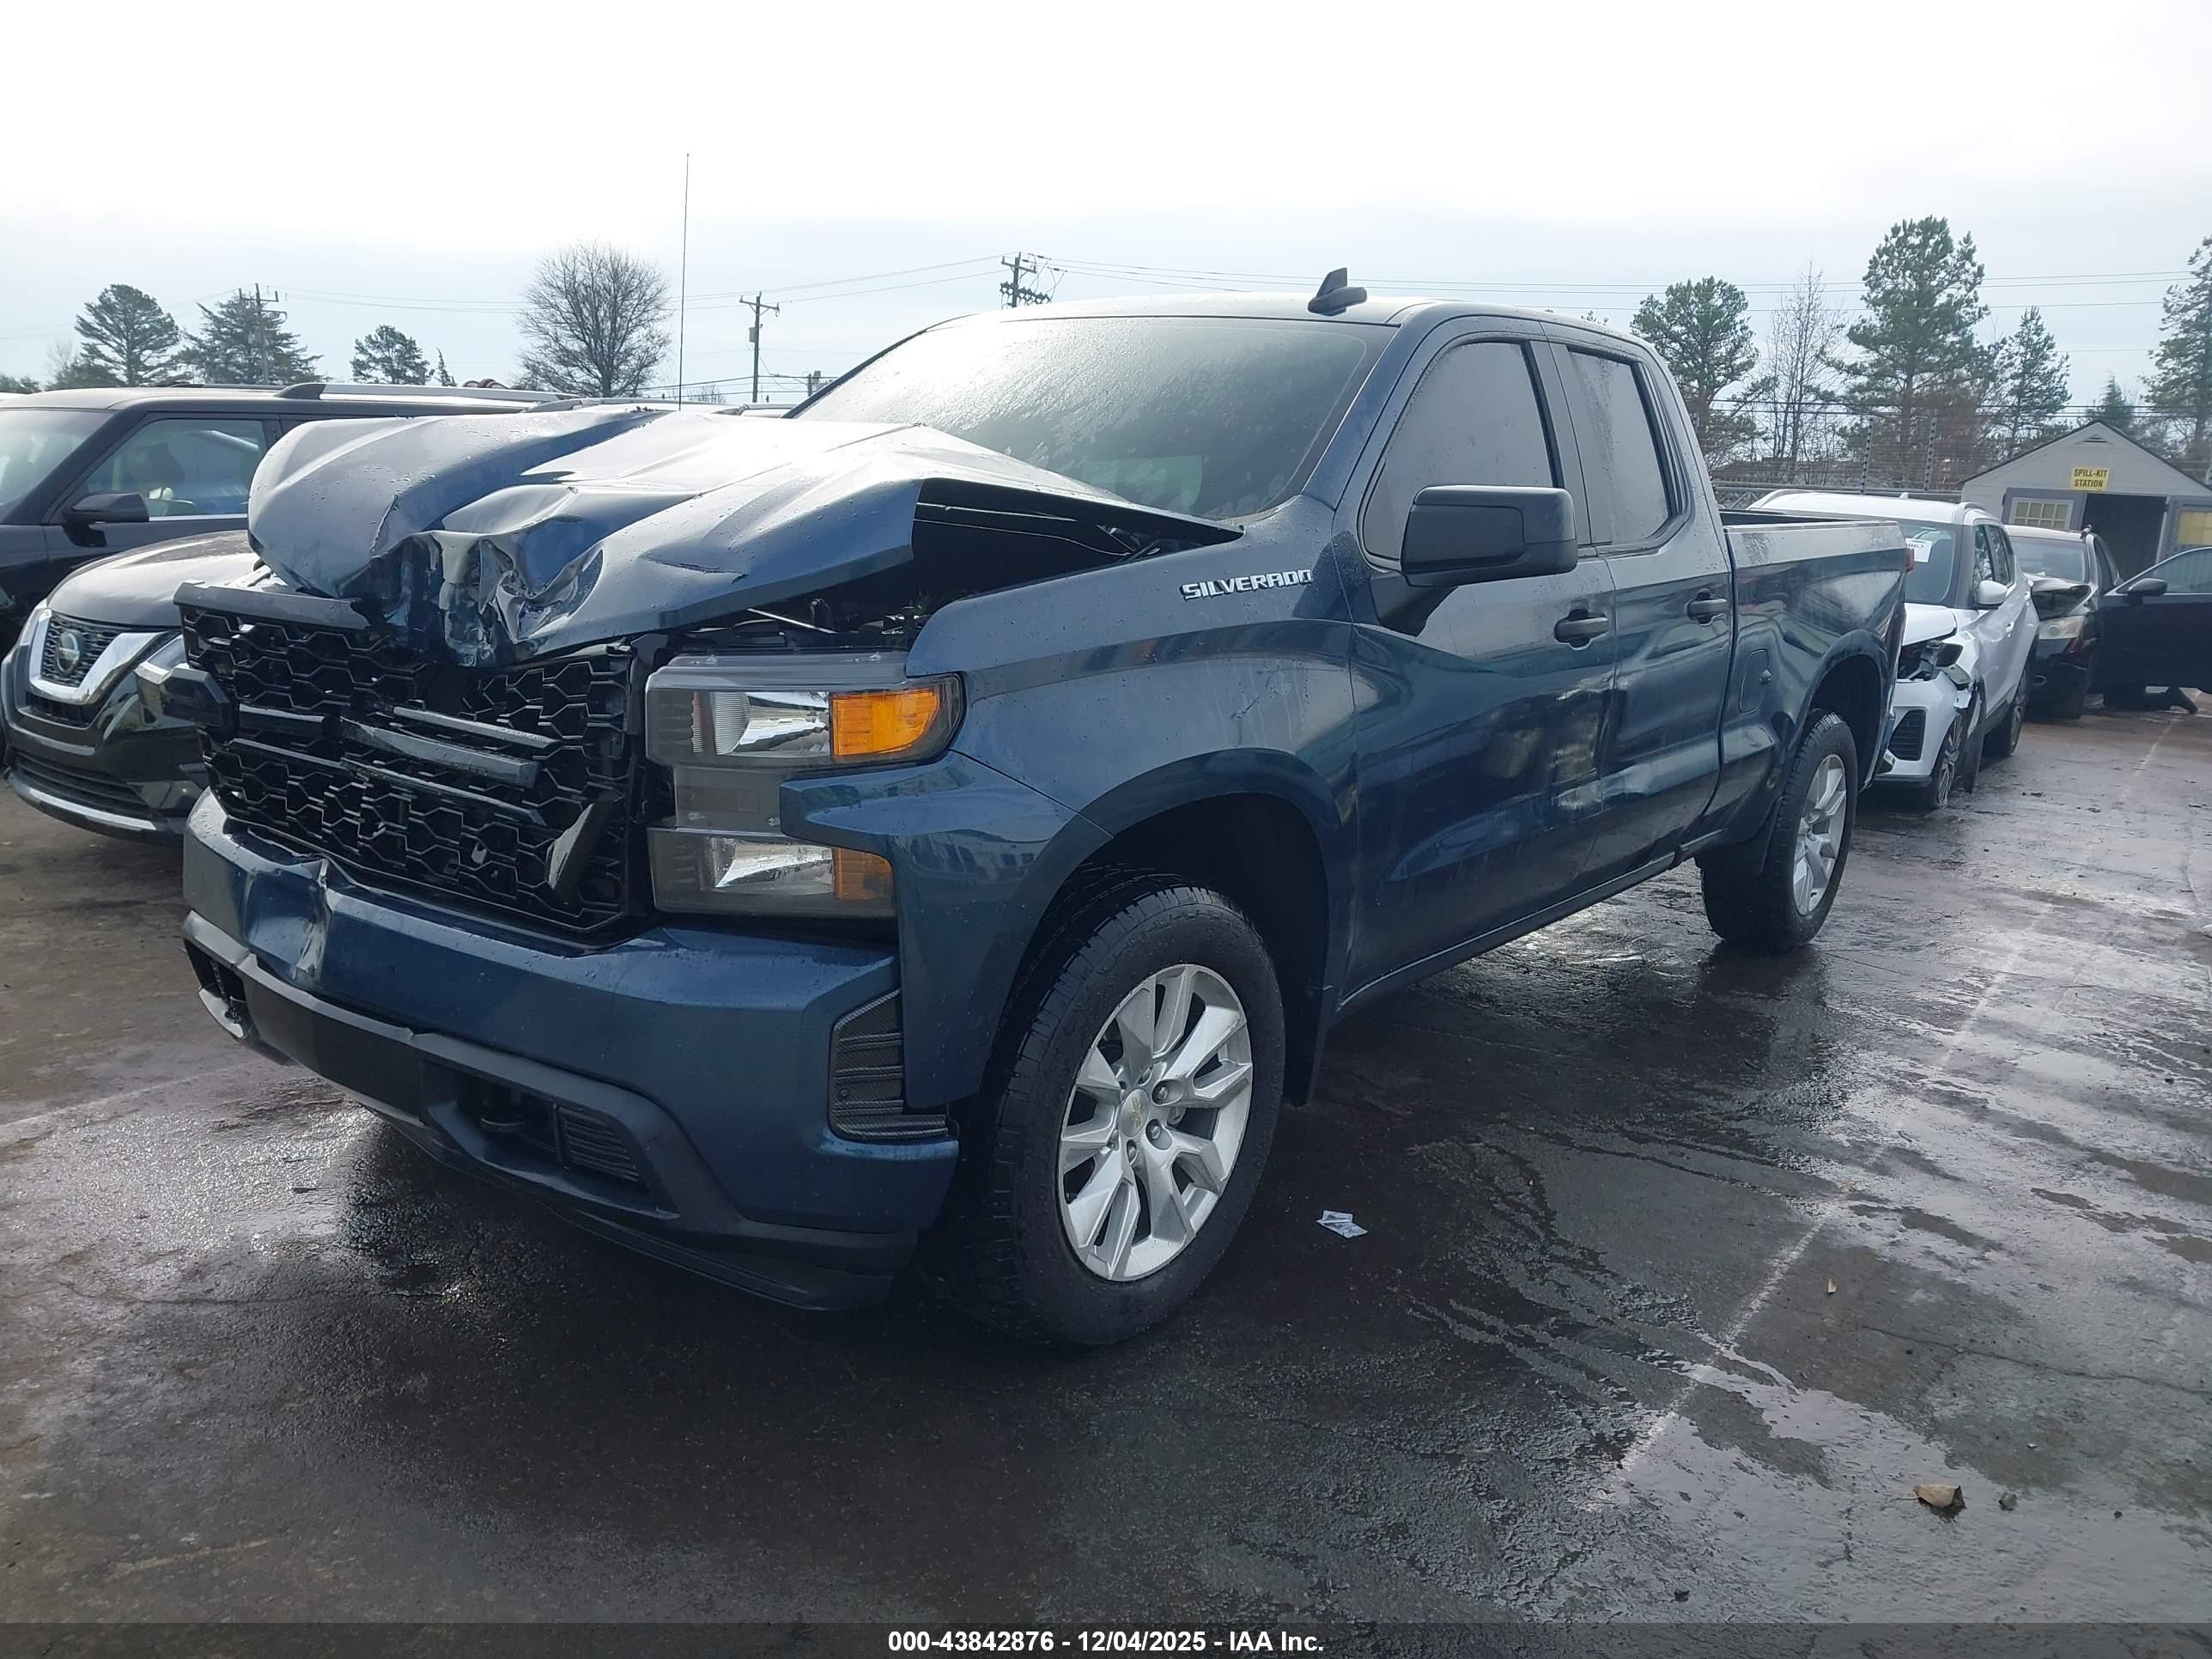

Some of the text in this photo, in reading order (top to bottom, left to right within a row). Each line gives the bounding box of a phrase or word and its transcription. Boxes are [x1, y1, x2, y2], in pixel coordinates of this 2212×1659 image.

[2074, 468, 2108, 477] SPILL-KIT
[2074, 478, 2103, 488] STATION
[1181, 569, 1313, 600] SILVERADO
